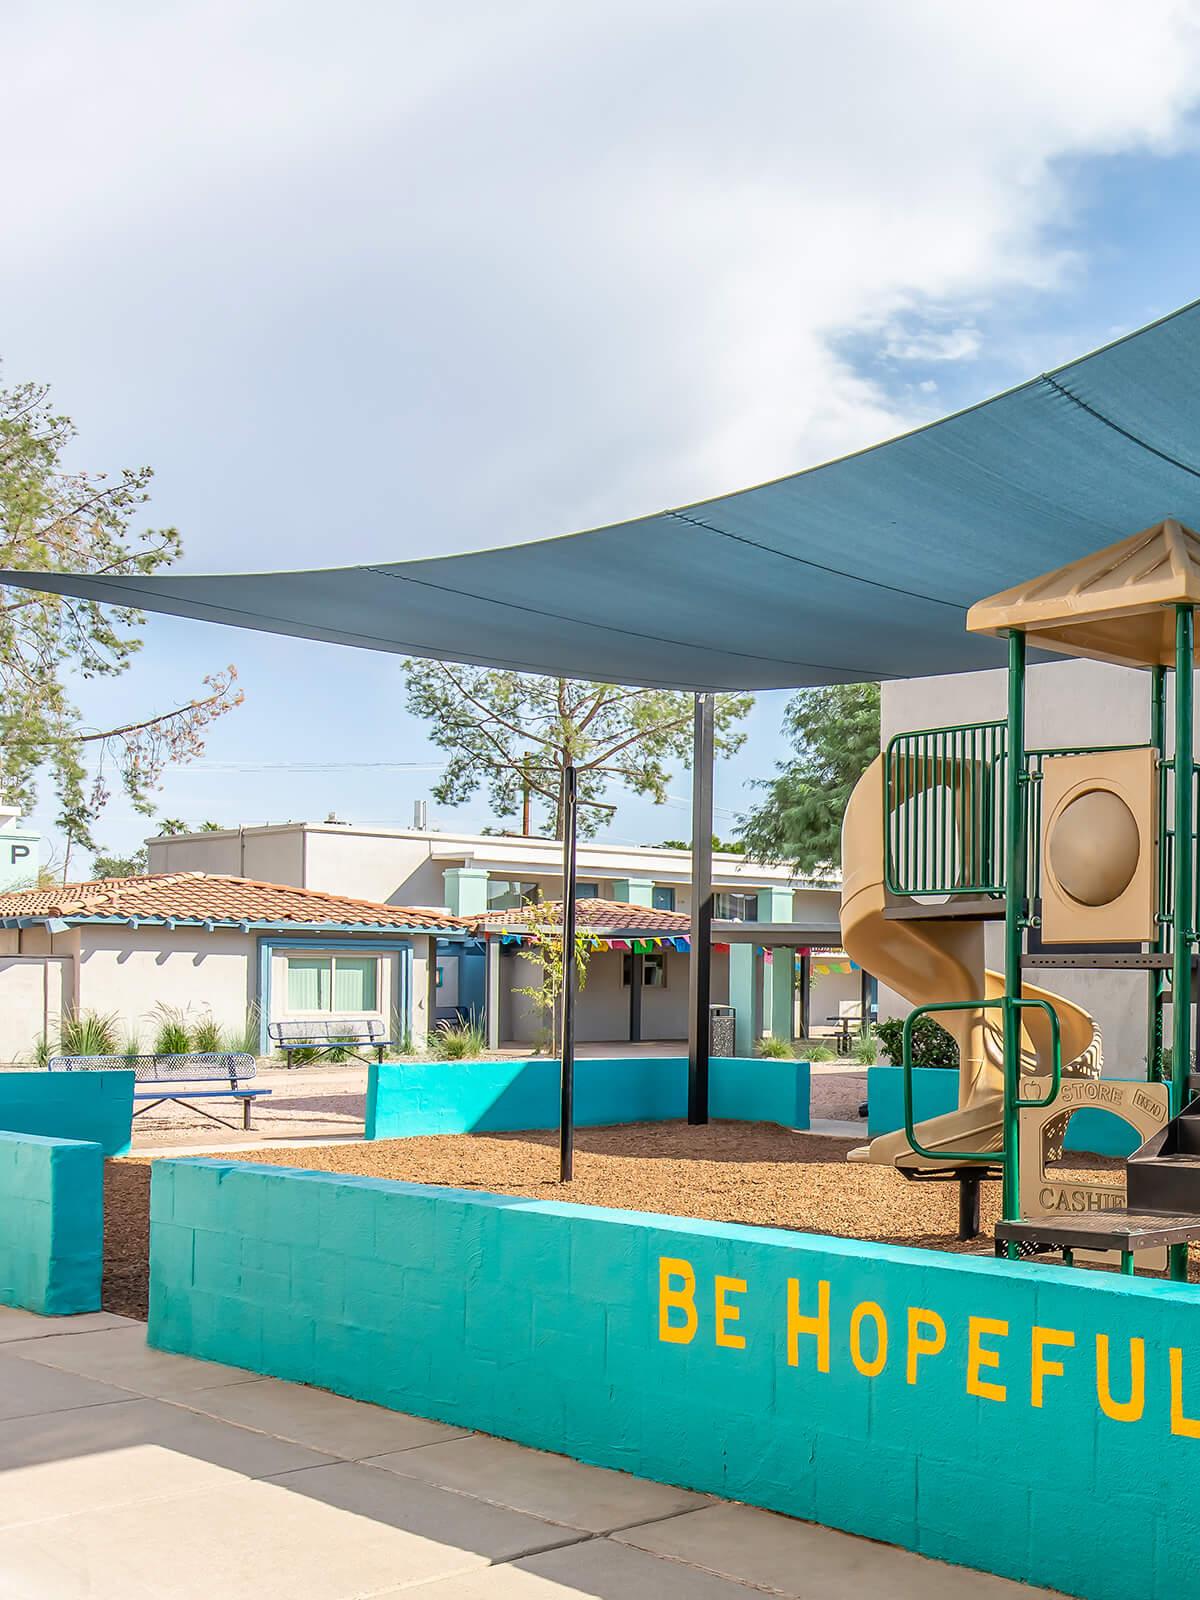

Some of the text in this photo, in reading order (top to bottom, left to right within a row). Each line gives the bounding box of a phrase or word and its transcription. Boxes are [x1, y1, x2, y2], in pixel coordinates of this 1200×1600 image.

[11, 844, 30, 865] P
[1062, 1083, 1124, 1105] STORE
[1039, 1187, 1127, 1212] CASHIE
[659, 1256, 747, 1349] BE
